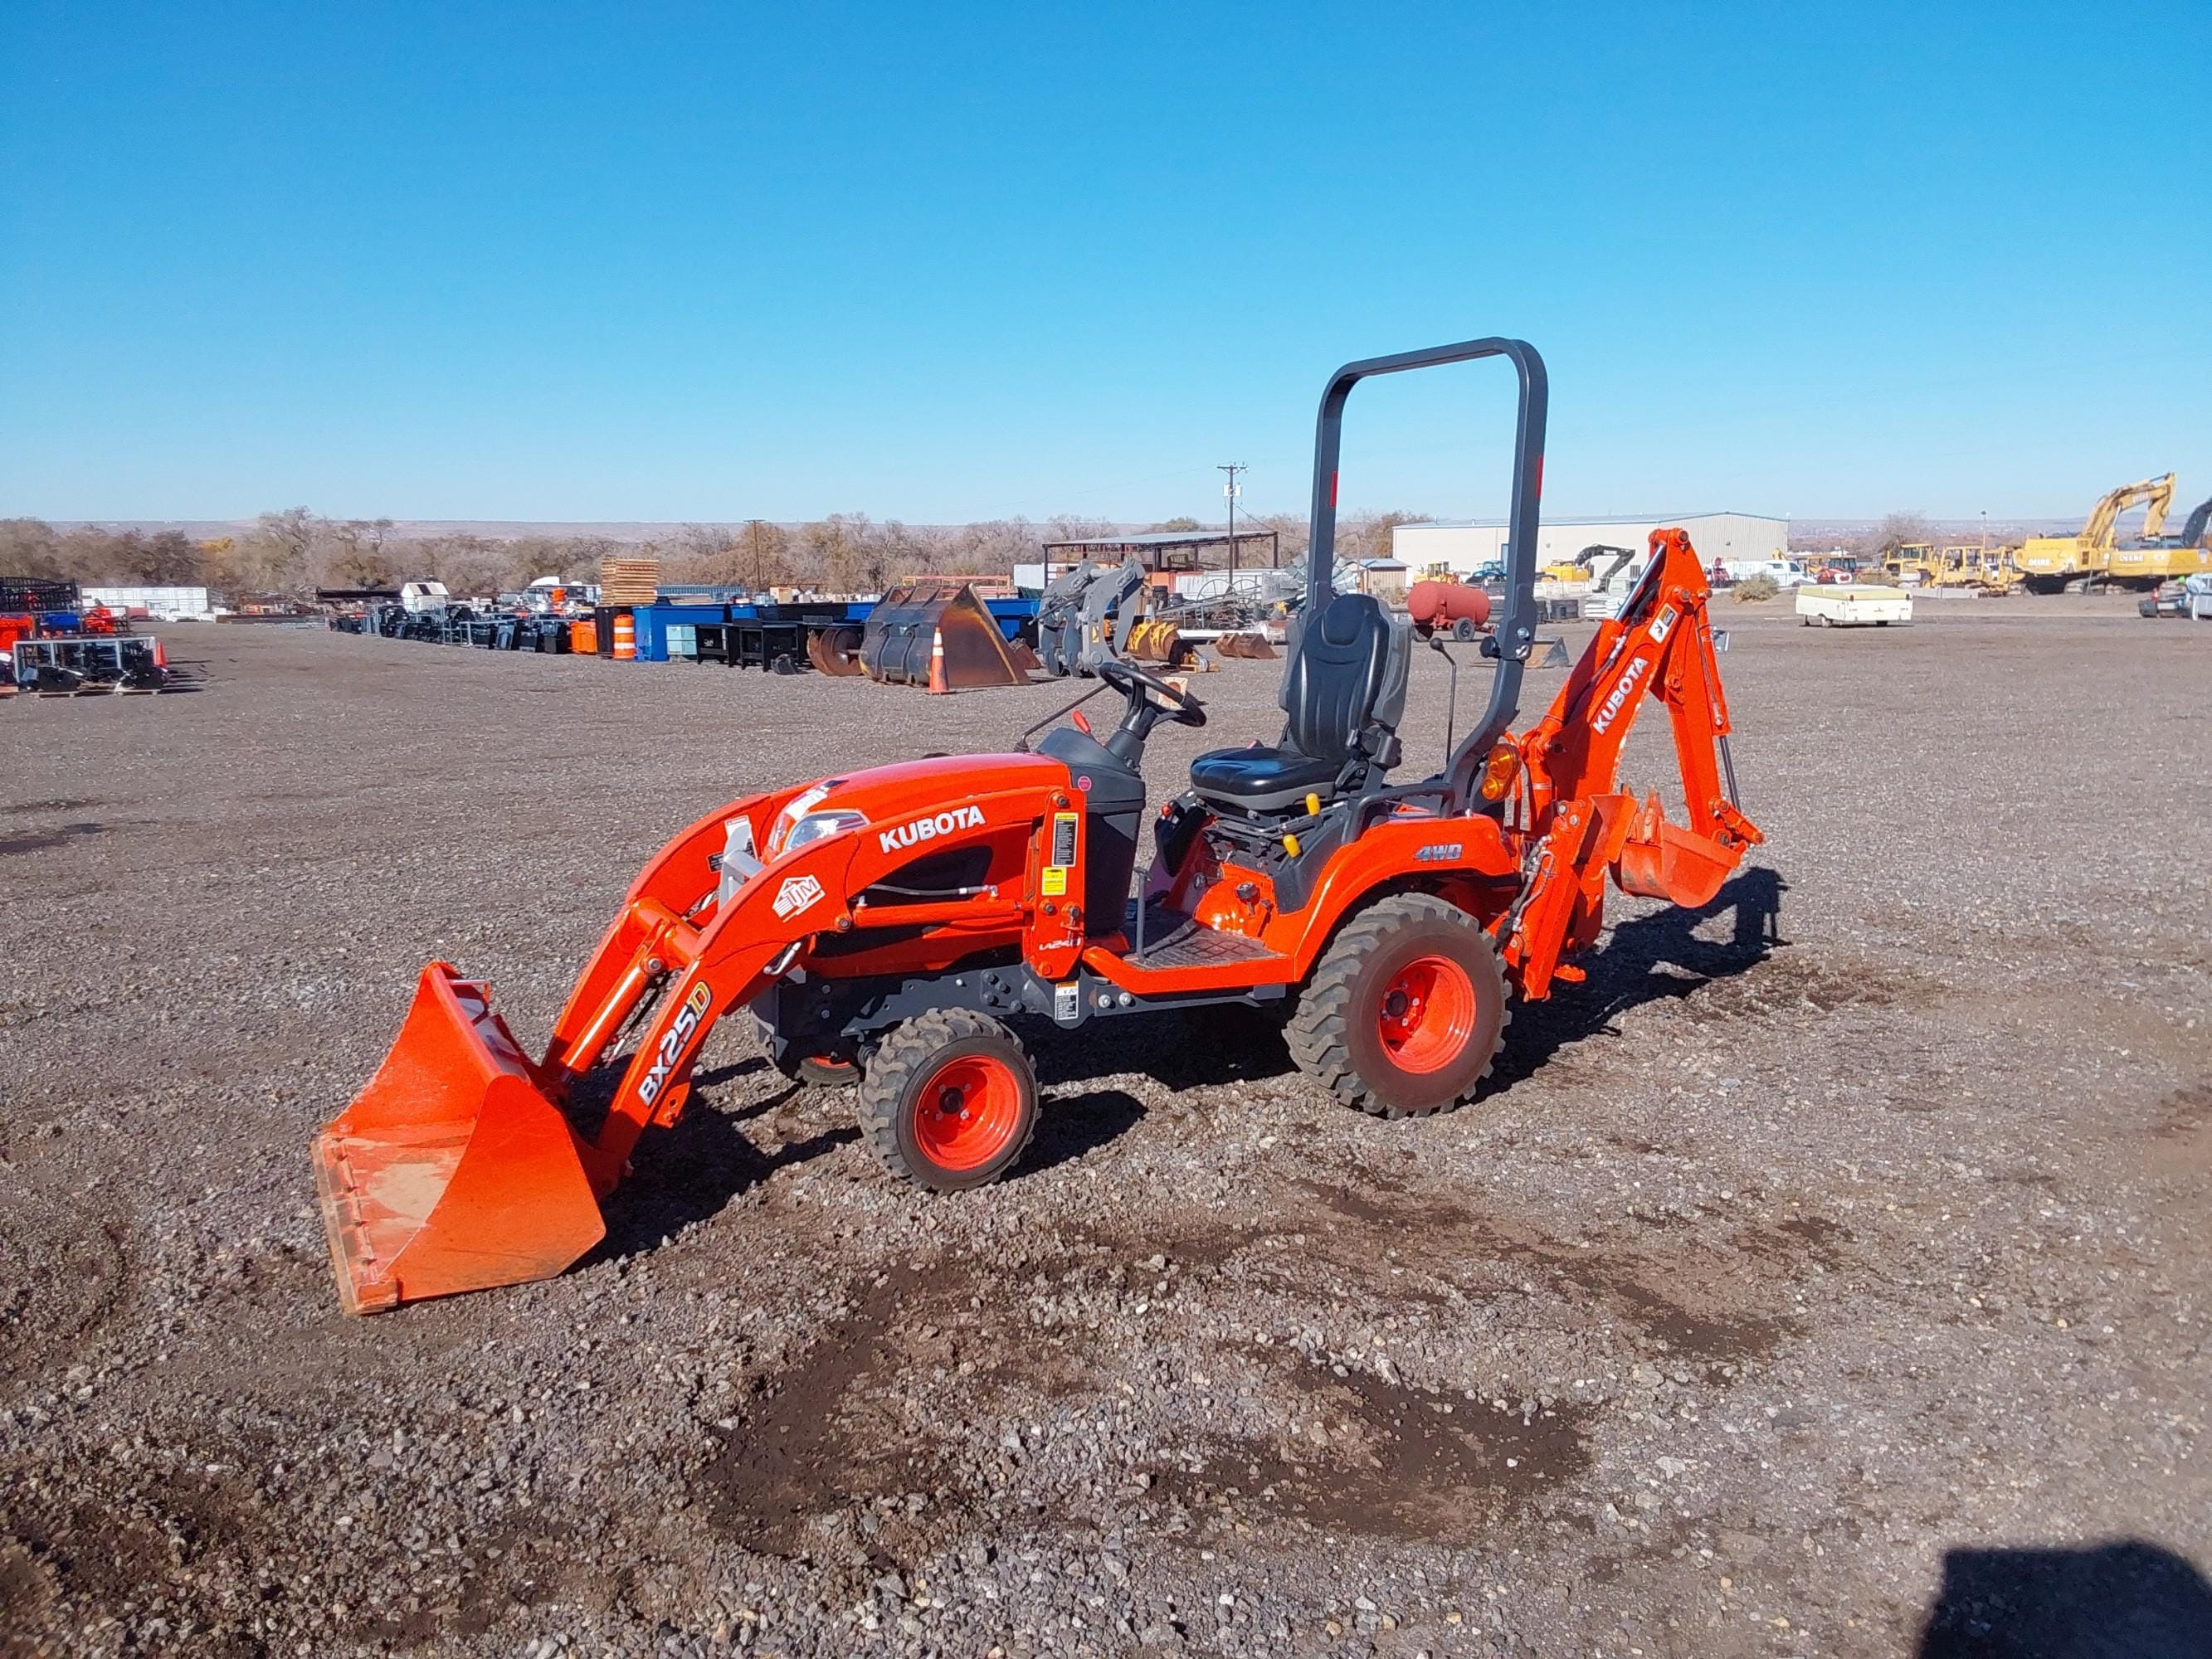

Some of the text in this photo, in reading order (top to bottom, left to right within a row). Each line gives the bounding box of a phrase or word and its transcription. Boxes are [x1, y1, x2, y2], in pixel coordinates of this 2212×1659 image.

[1592, 656, 1649, 736] KUBOTA
[879, 805, 987, 854] KUBOTA
[1414, 843, 1463, 861] 4WD
[637, 980, 711, 1107] BX25D
